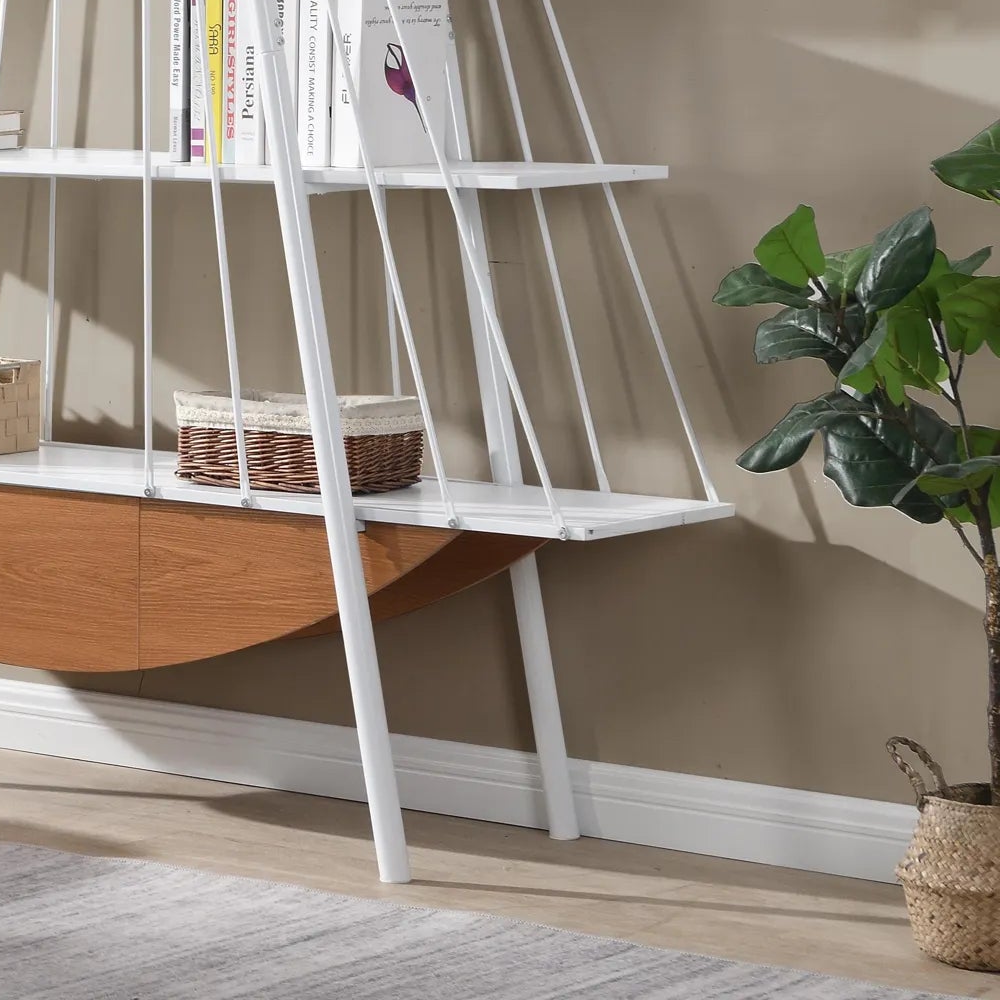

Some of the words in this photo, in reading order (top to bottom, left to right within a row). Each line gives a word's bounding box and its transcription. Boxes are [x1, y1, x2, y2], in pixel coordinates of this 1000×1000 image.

[173, 17, 181, 41] Power
[173, 44, 181, 66] Made
[308, 35, 316, 74] CONSIST
[172, 68, 181, 87] Easy
[241, 45, 255, 119] Persiana
[307, 77, 316, 113] MAKING
[306, 123, 315, 157] CHOICE
